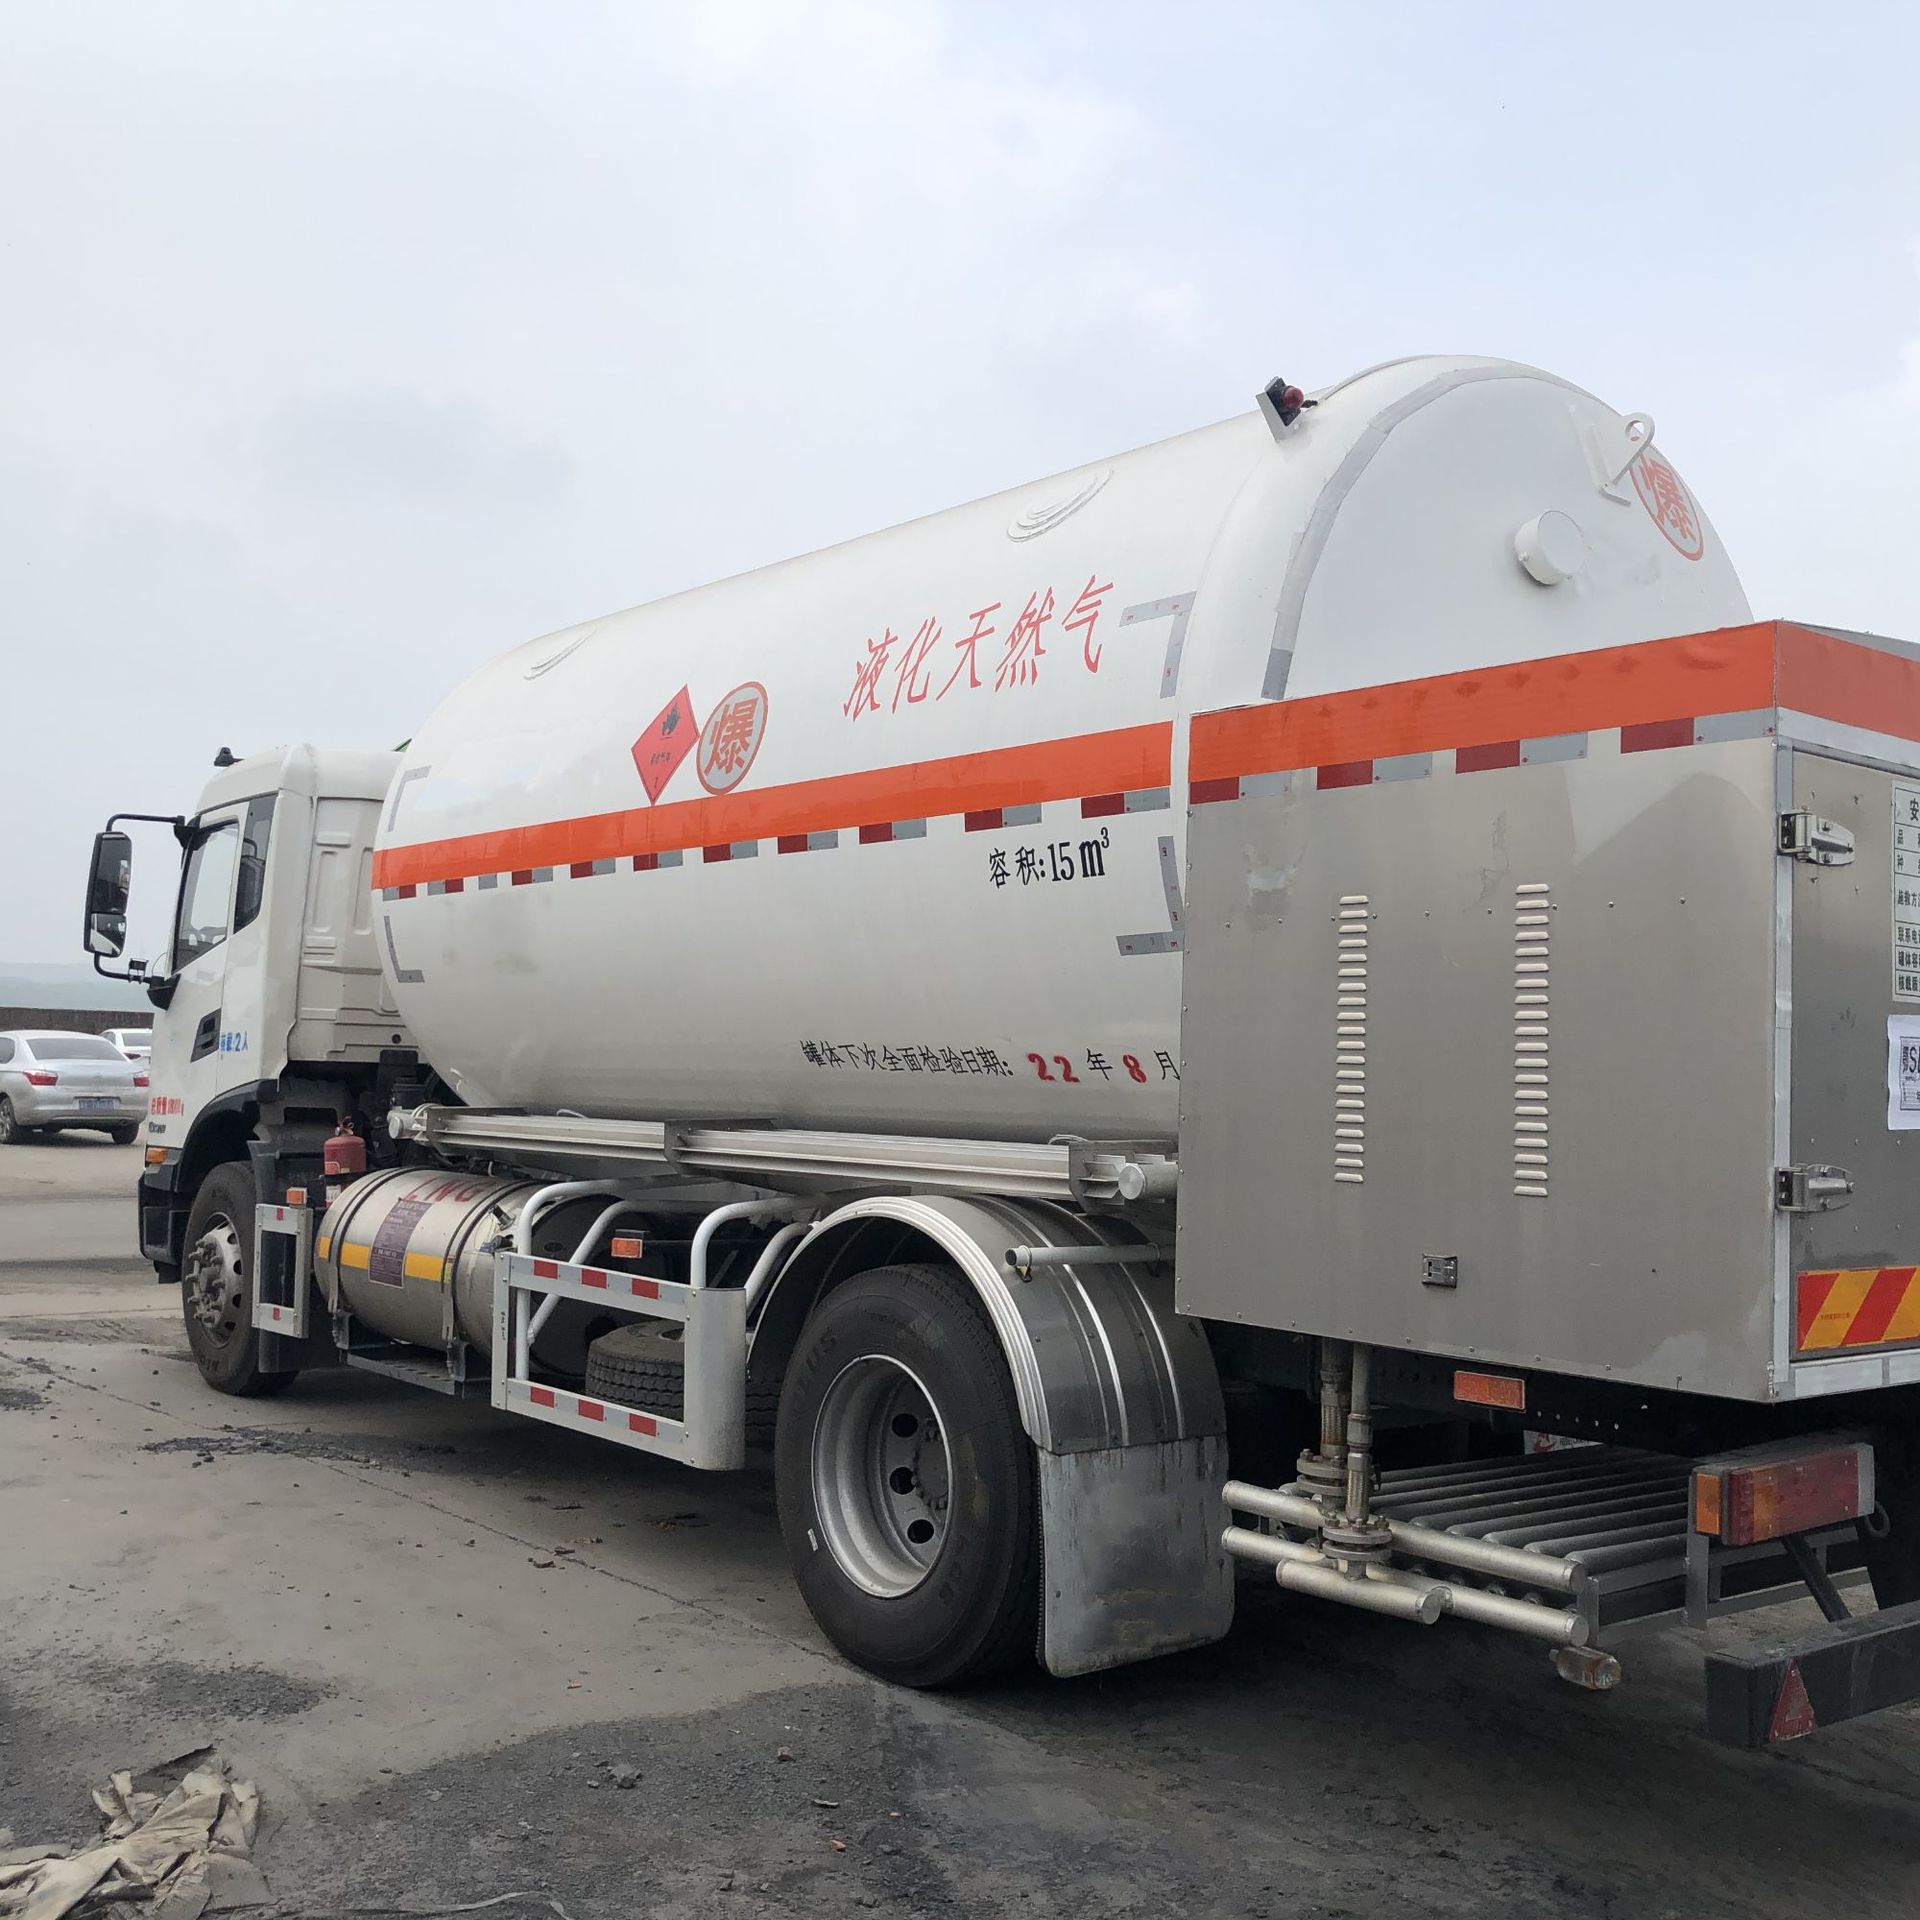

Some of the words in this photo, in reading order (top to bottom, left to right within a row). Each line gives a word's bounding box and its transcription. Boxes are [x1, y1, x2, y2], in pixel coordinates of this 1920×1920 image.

[1638, 450, 1697, 543] 爆
[843, 574, 1114, 721] 液化天然气
[704, 697, 759, 776] 爆
[1898, 950, 1920, 969] 罐体容
